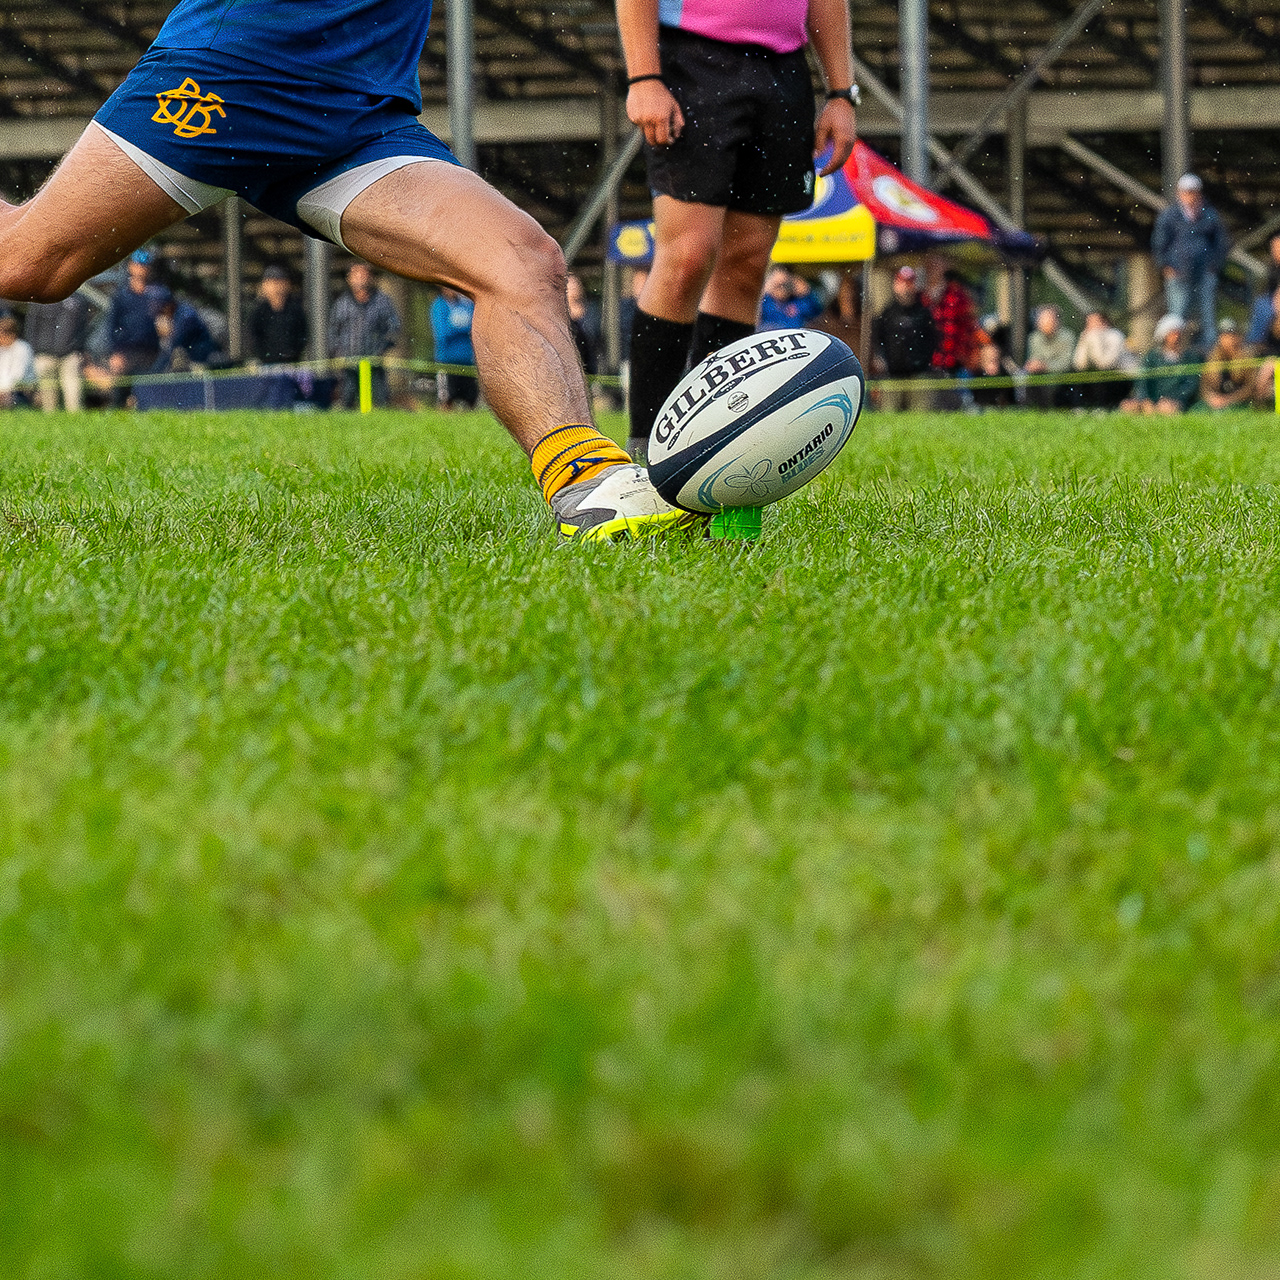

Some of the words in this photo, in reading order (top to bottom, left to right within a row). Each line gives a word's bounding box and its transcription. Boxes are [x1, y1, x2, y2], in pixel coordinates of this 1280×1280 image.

[655, 332, 807, 444] GILBERT
[777, 422, 834, 475] ONTARIO
[781, 445, 826, 485] BLUES
